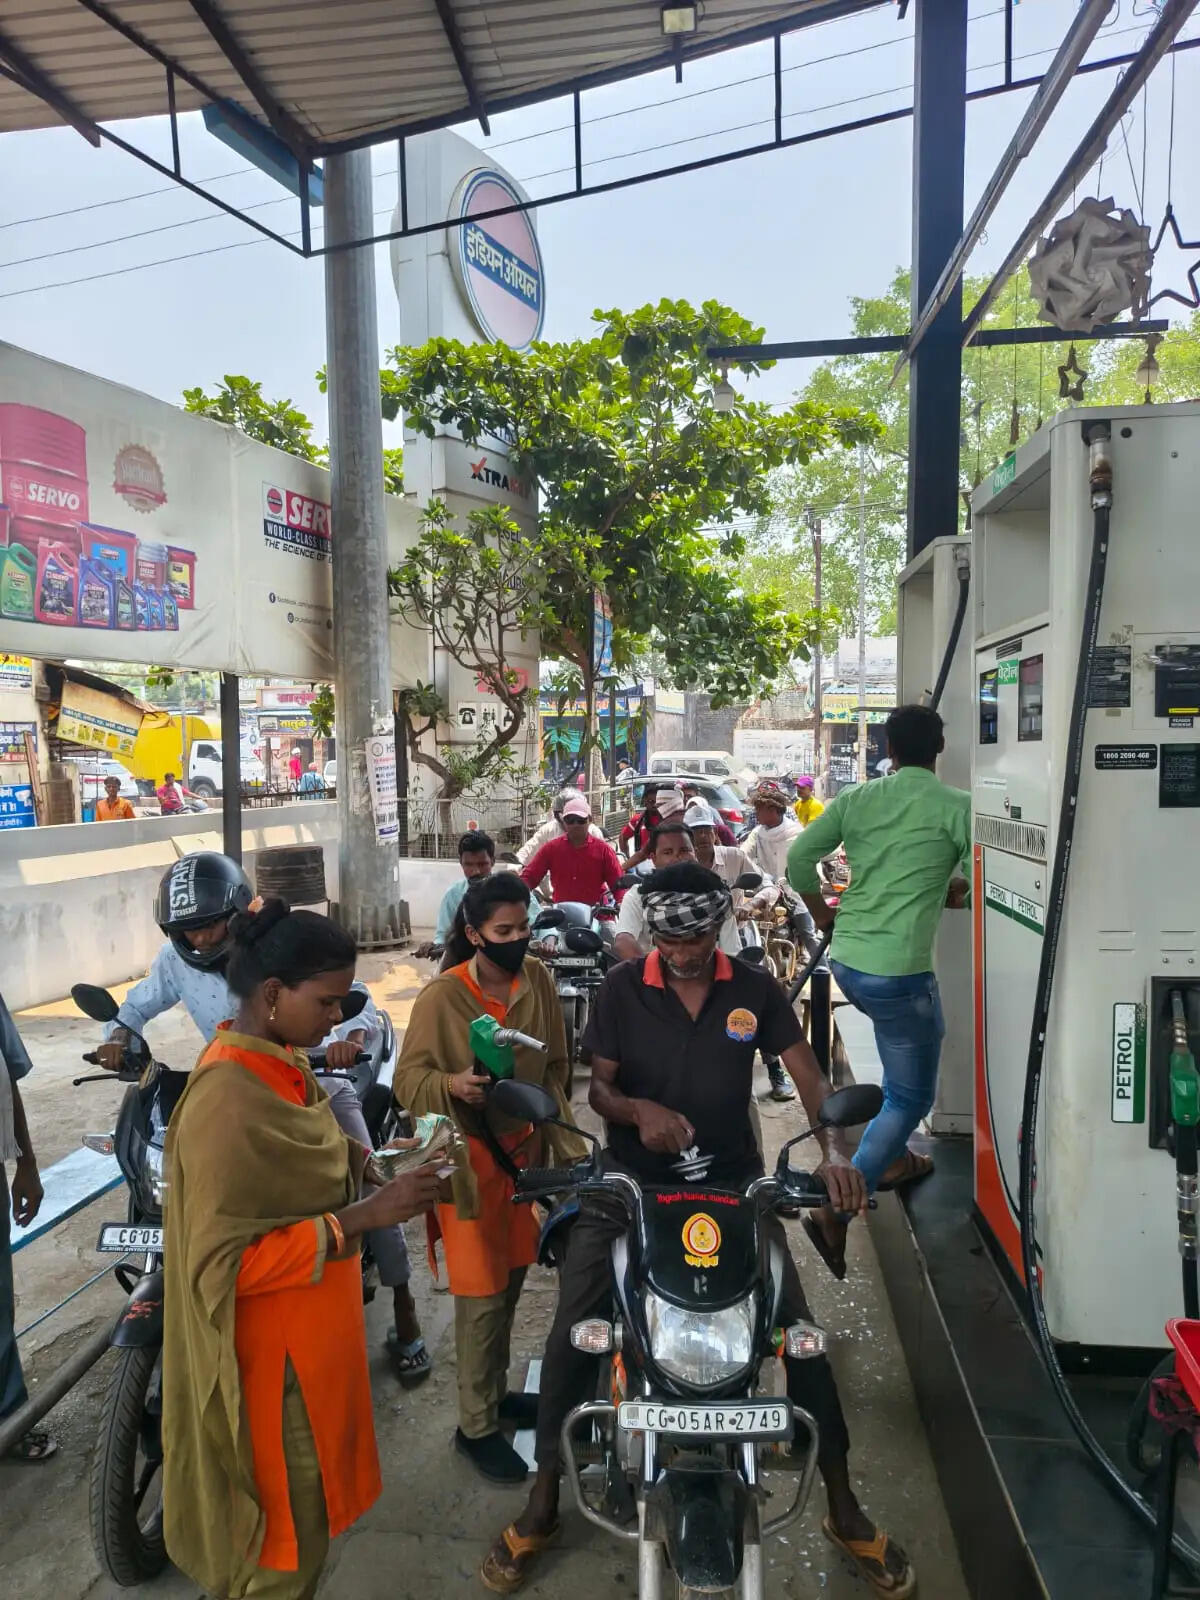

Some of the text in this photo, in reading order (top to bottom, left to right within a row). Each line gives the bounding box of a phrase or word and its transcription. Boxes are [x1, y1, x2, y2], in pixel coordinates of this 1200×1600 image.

[467, 226, 537, 302] इंडियन ऑयल
[28, 483, 80, 510] SERVO
[289, 497, 331, 538] SER
[265, 538, 281, 549] THE
[283, 544, 315, 559] SCIENCE
[998, 662, 1017, 683] पेट्रोल
[990, 885, 1038, 920] PETROL PETROL
[1116, 1027, 1132, 1100] PETROL
[736, 1410, 780, 1431] 2749
